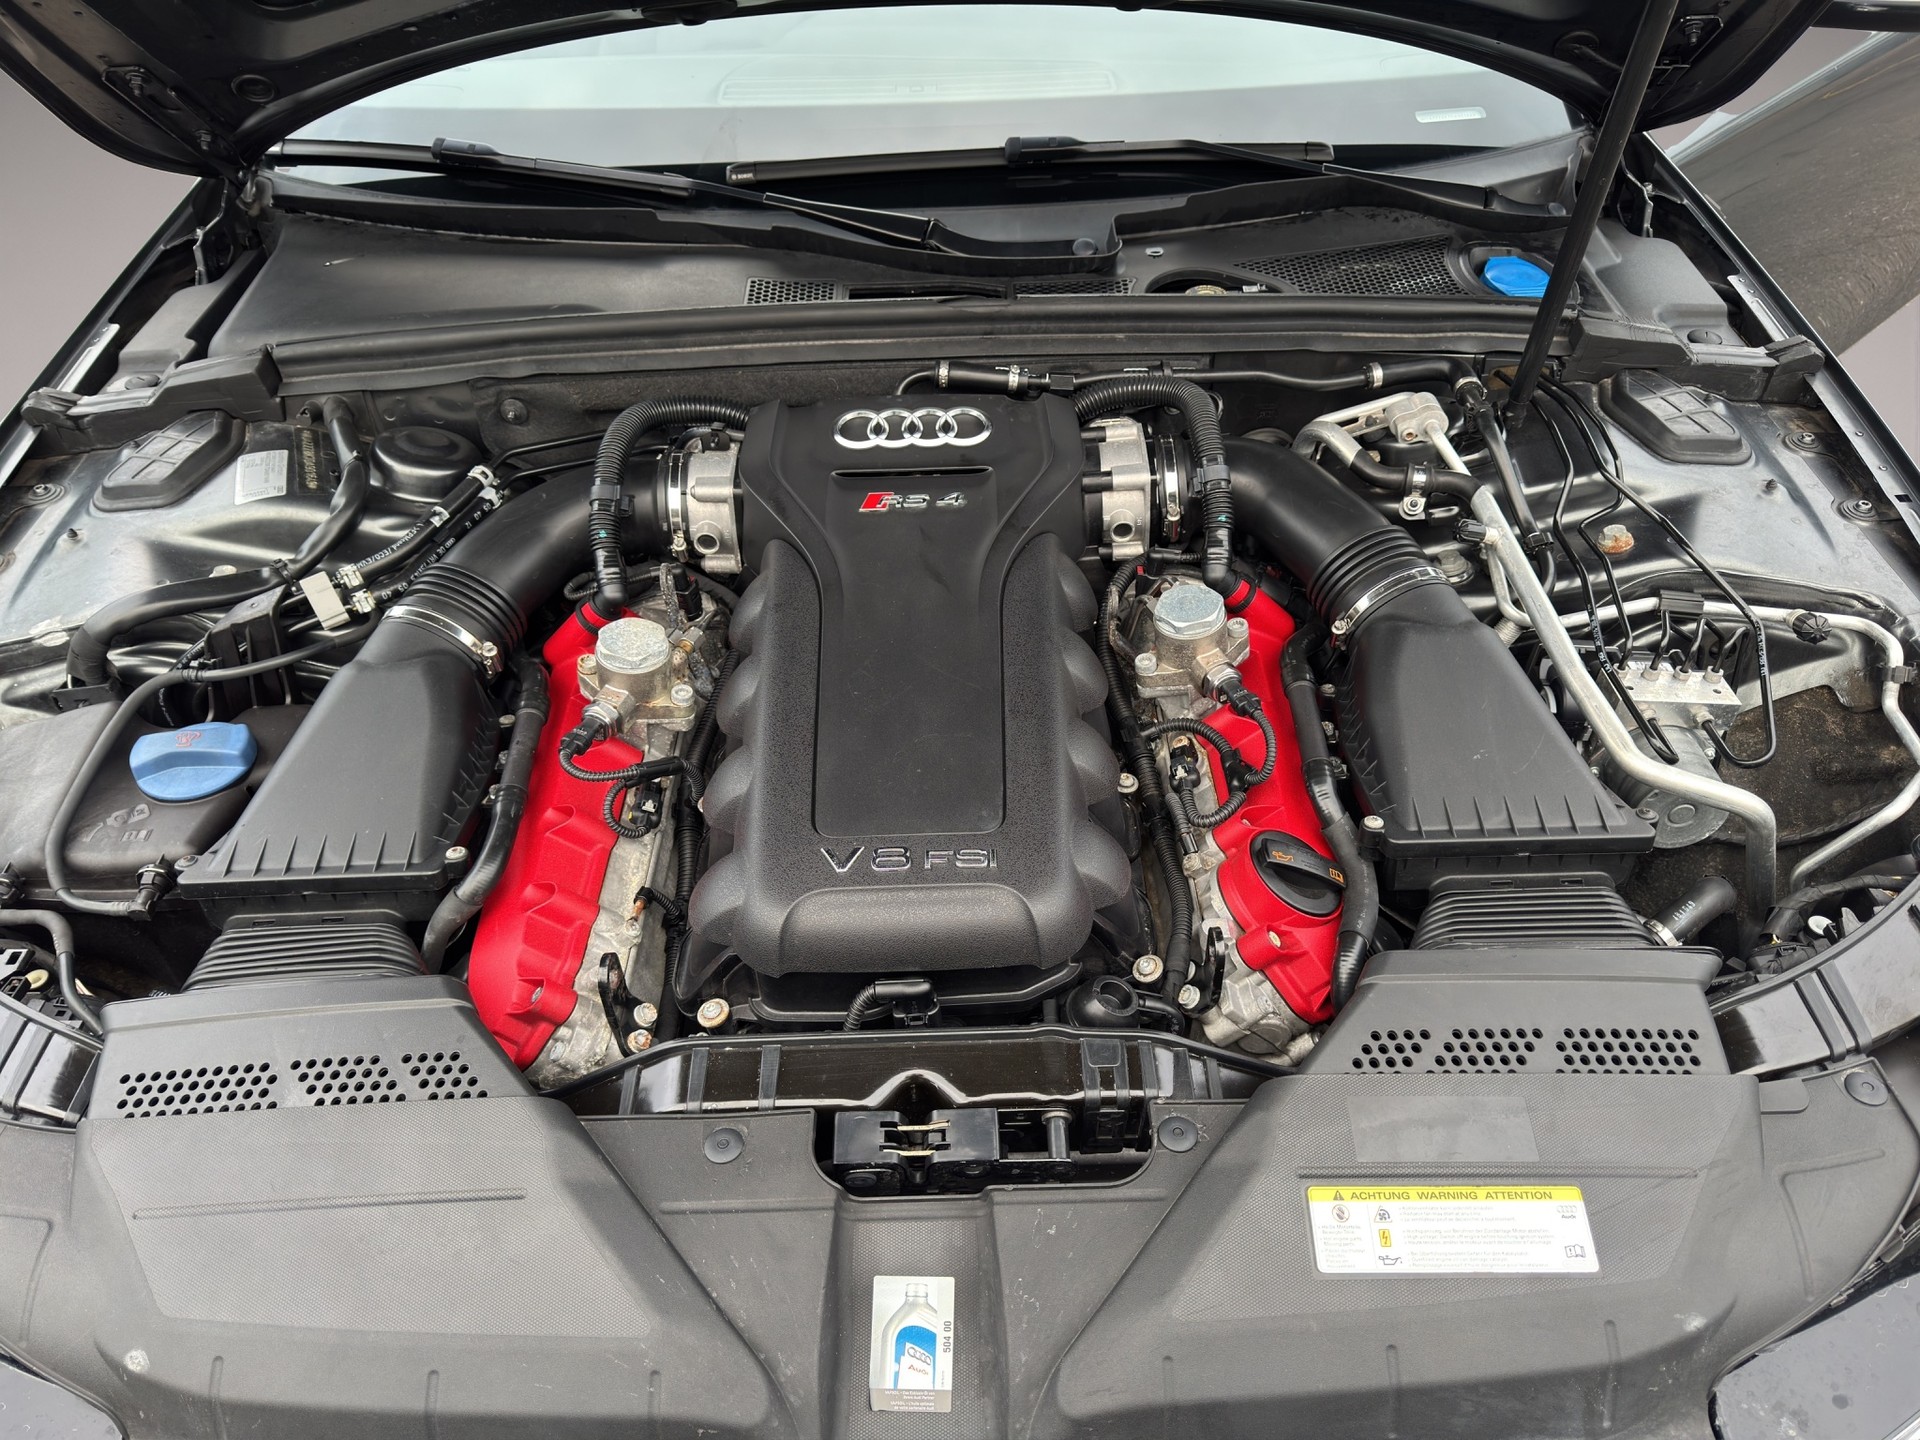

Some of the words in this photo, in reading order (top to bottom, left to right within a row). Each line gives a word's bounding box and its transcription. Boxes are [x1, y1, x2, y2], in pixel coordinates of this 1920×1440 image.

[936, 492, 967, 508] 4
[397, 582, 409, 593] 05
[381, 590, 392, 600] 40
[924, 849, 998, 870] FSI
[1350, 1191, 1411, 1200] ACHTUNG
[1416, 1191, 1478, 1200] WARNING
[1485, 1191, 1553, 1200] ATTENTION
[943, 1320, 952, 1332] 00
[943, 1336, 951, 1353] 504
[908, 1364, 929, 1376] Audi
